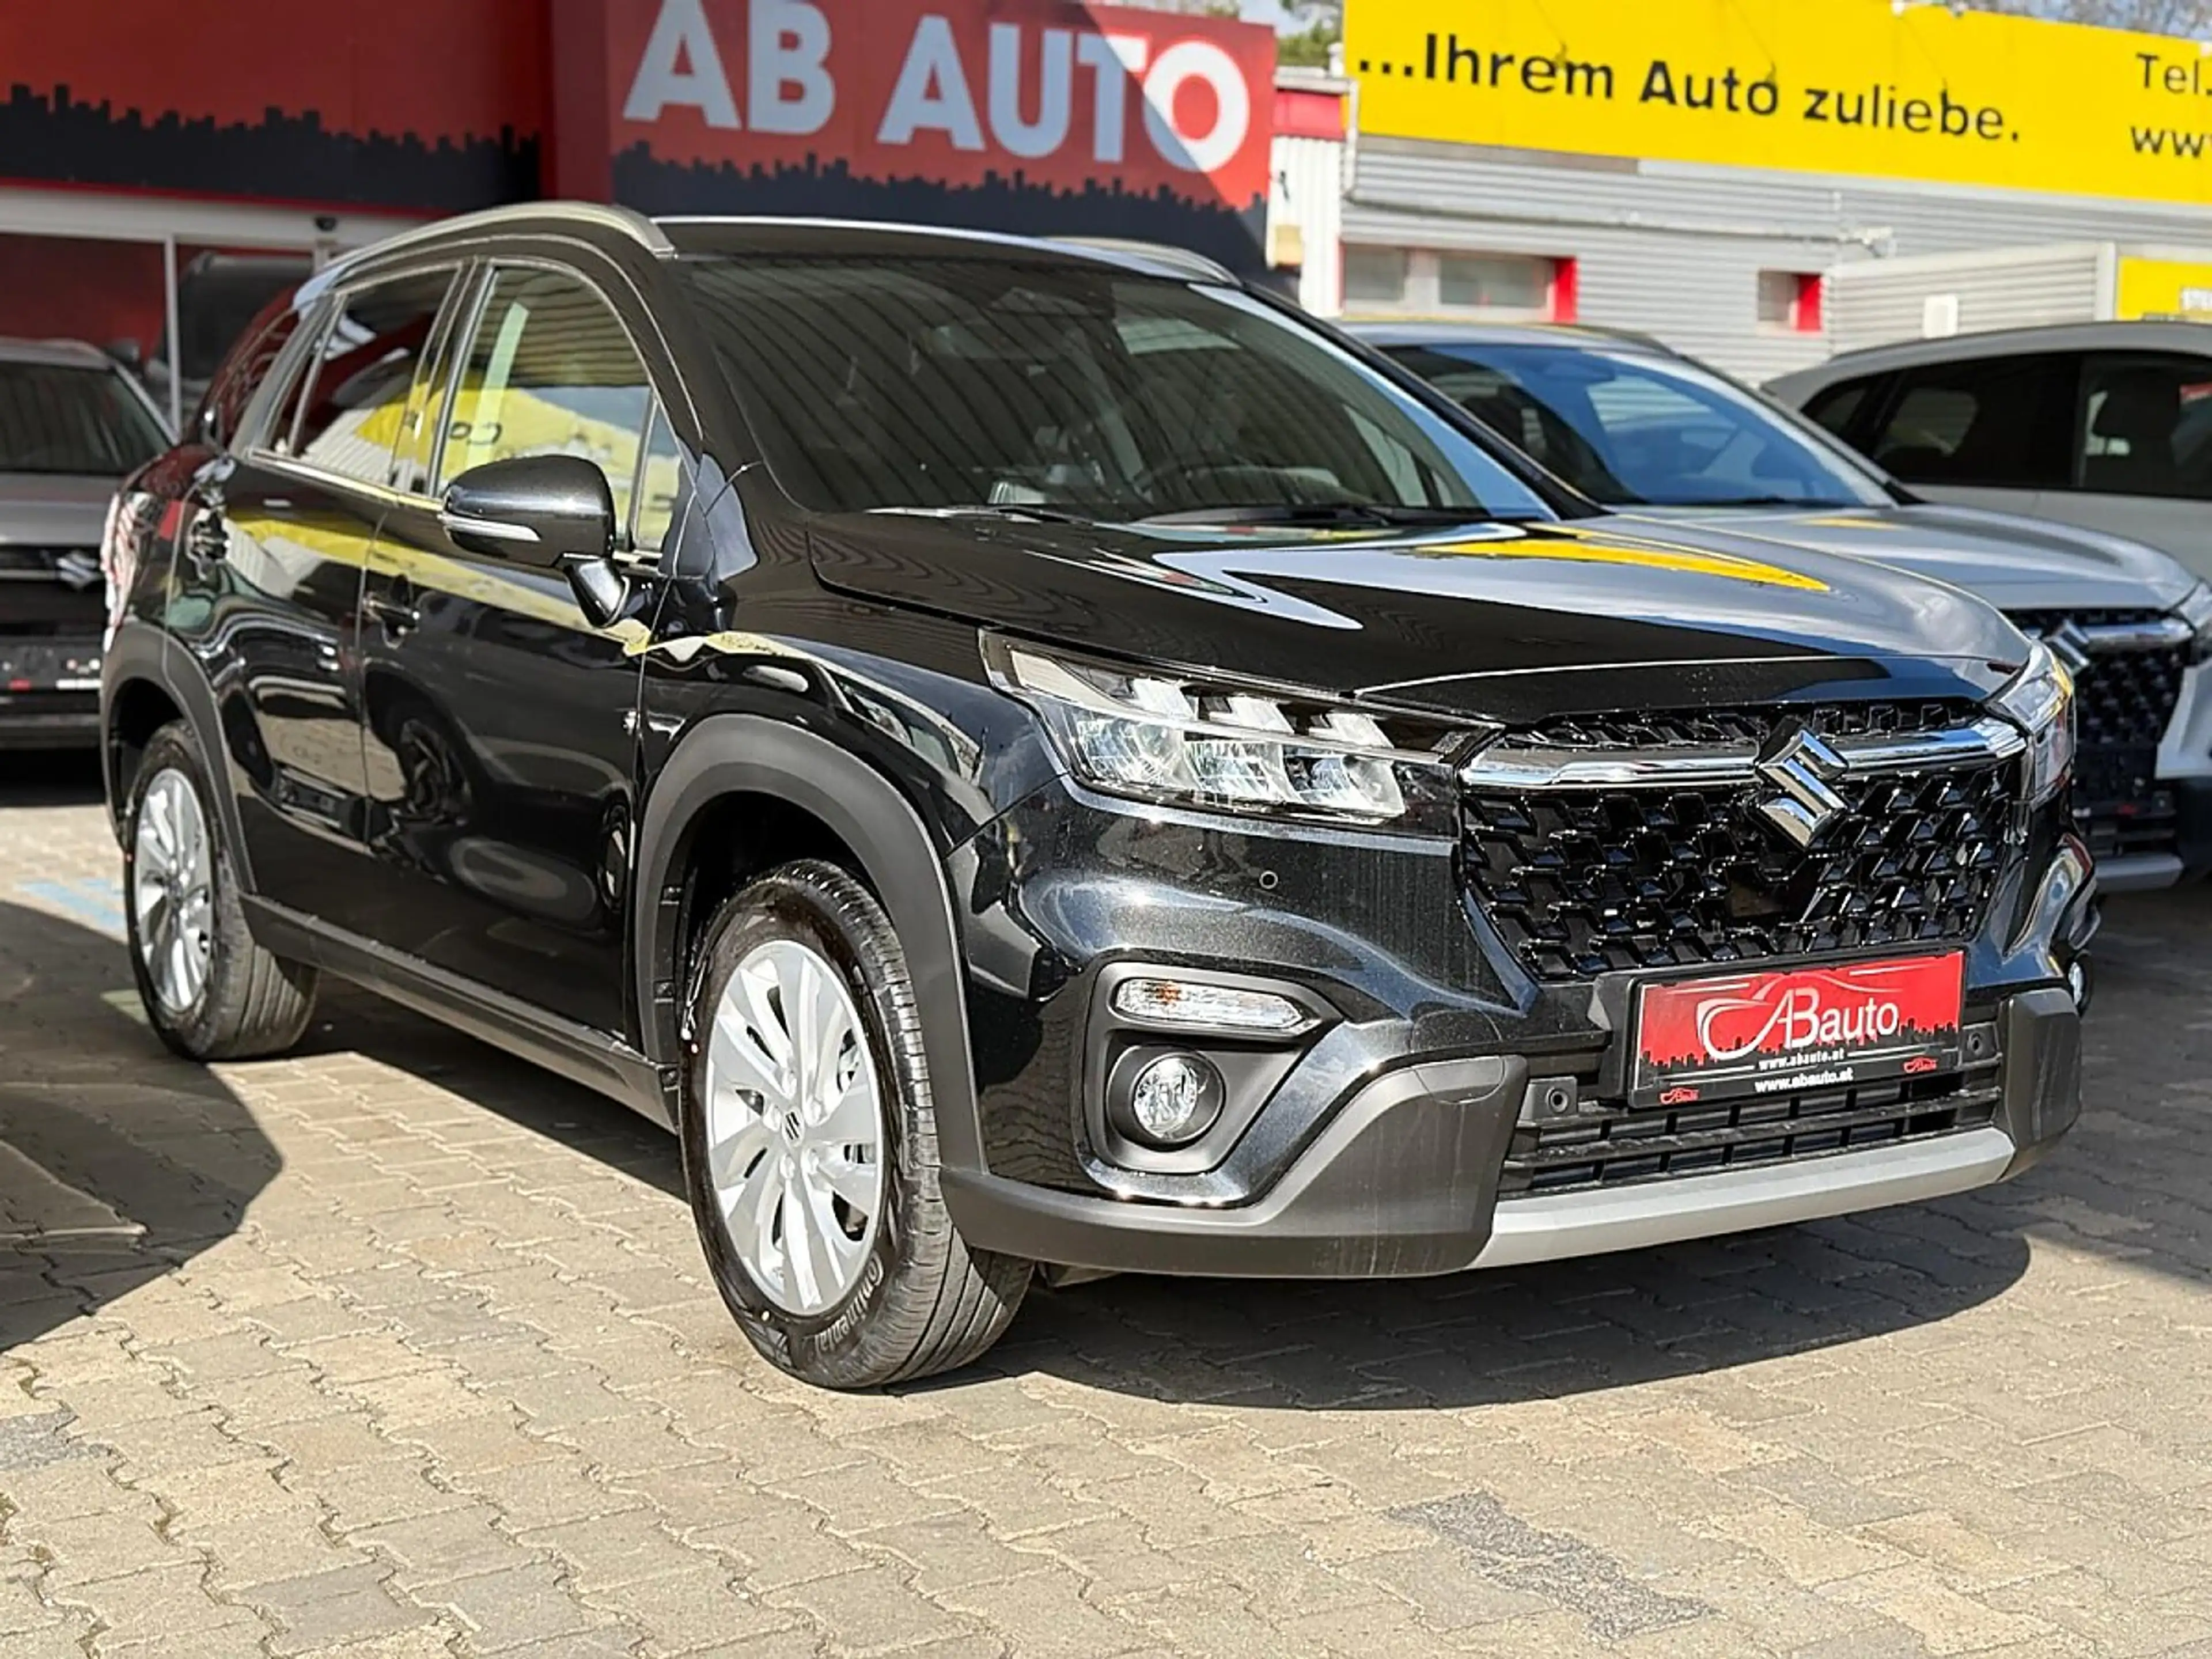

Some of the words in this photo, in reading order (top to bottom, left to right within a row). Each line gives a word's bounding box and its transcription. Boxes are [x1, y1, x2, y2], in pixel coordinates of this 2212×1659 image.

[622, 0, 836, 135] AB
[875, 14, 1251, 173] AUTO
[1359, 33, 1615, 99] ...Ihrem
[1639, 60, 1779, 116] Auto
[1802, 84, 2020, 142] zuliebe.
[2130, 124, 2212, 158] ww
[1758, 1047, 1845, 1071] www.abauto.at
[1754, 1067, 1854, 1093] www.abauto.at
